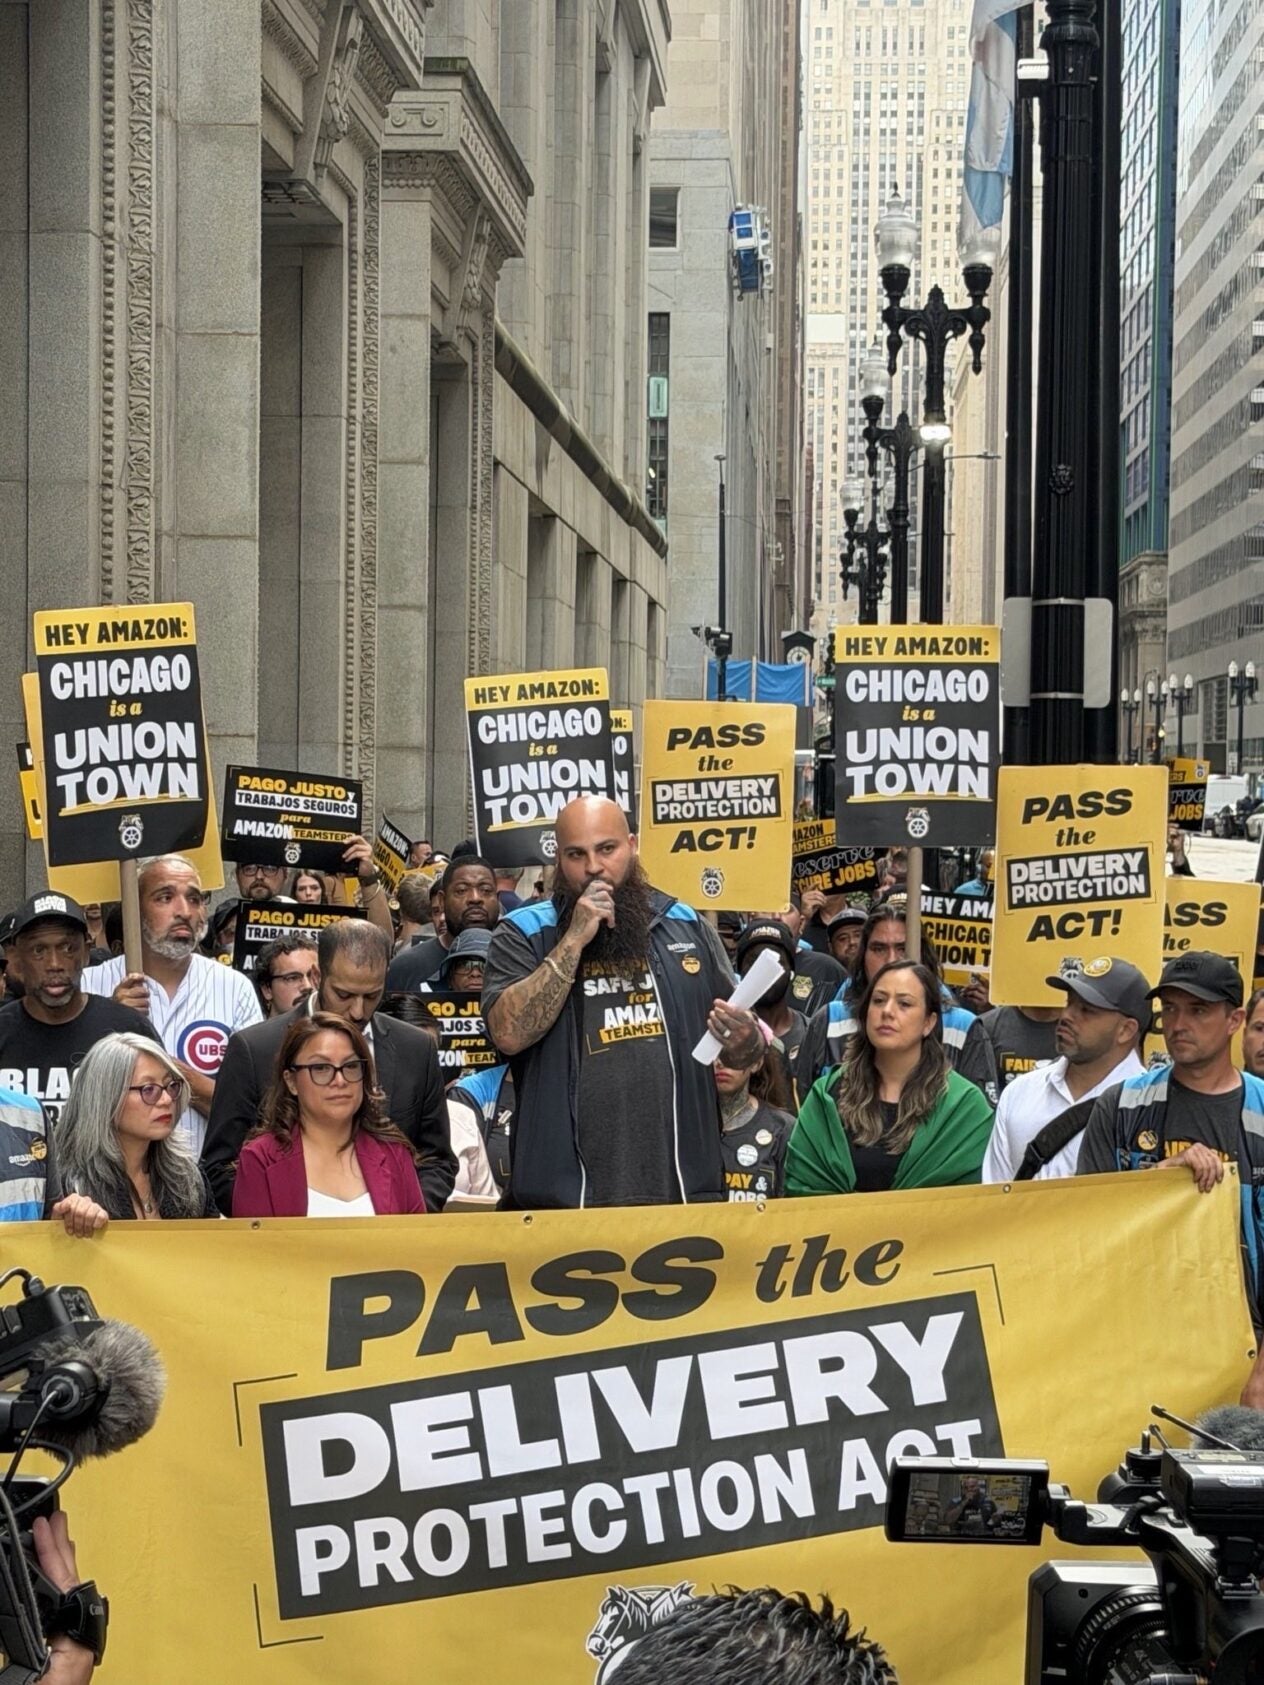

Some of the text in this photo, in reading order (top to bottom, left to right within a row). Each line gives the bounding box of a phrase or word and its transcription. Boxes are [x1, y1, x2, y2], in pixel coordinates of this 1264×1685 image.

[45, 617, 188, 646] HEY AMAZON:
[846, 637, 989, 656] HEY AMAZON:
[50, 653, 191, 700] CHICAGO
[846, 669, 989, 702] CHICAGO
[474, 679, 600, 704] HEY AMAZON:
[109, 699, 143, 717] is a
[902, 705, 936, 720] is a
[478, 707, 602, 744] CHICAGO
[667, 722, 766, 751] PASS
[54, 721, 197, 770] UNION
[528, 742, 558, 756] is a
[846, 726, 989, 764] UNION
[698, 755, 734, 772] the
[56, 762, 199, 810] TOWN
[238, 775, 287, 792] PAGO
[289, 781, 346, 799] JUSTO
[482, 759, 607, 796] UNION
[655, 778, 775, 802] DELIVERY
[846, 763, 989, 799] TOWN
[237, 792, 355, 815] TRABAJOS SEGUROS
[484, 790, 607, 827] TOW
[656, 797, 776, 820] PROTECTION
[1022, 788, 1133, 825] PASS
[1169, 804, 1203, 820] JOBS
[233, 819, 294, 840] AMAZON
[279, 813, 312, 824] para
[670, 826, 757, 853] ACT!
[793, 822, 824, 842] AZON
[1056, 827, 1096, 847] the
[794, 847, 876, 877] eserve
[834, 860, 876, 886] JOBS
[1010, 851, 1144, 884] DELIVERY
[1011, 874, 1145, 905] PROTECTION
[249, 910, 294, 925] PAGO
[921, 895, 956, 915] HEY
[1164, 902, 1228, 927] SS
[923, 921, 991, 945] CHICAG
[1026, 908, 1122, 943] ACT!
[1163, 933, 1191, 951] he
[583, 977, 634, 996] SAFE
[629, 992, 653, 1004] for
[604, 1003, 661, 1028] AMAZ
[450, 1038, 486, 1049] para
[605, 1023, 664, 1041] TEAMST
[437, 1050, 467, 1067] ZON
[0, 1067, 80, 1099] BLA
[755, 1176, 767, 1191] &
[326, 1234, 903, 1371] PASS the
[282, 1311, 964, 1506] DELIVERY
[295, 1448, 815, 1597] PROTECTION
